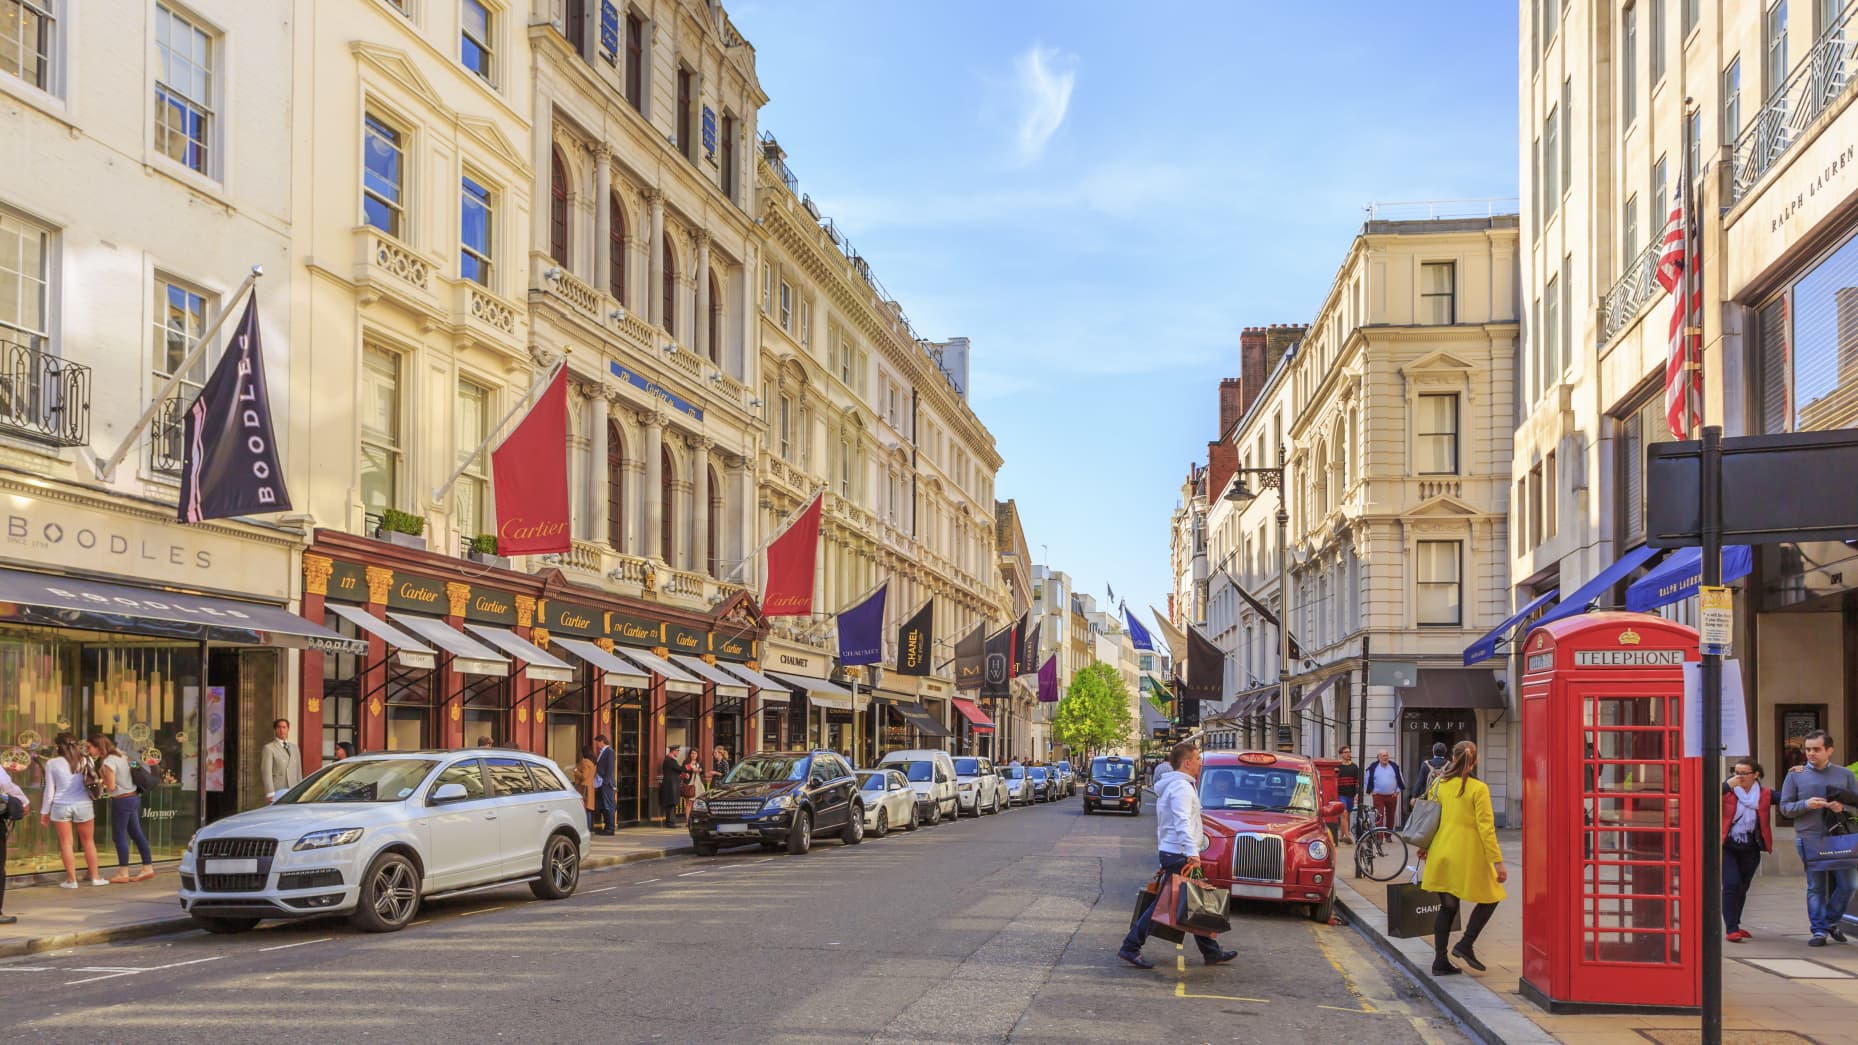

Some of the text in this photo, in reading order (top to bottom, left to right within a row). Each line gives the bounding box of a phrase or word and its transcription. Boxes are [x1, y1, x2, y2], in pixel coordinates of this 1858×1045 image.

[1771, 144, 1854, 233] RALPH LAUREN
[501, 518, 568, 539] Cartier
[8, 515, 212, 568] BOODLES
[340, 577, 356, 589] 177
[400, 582, 438, 603] Cartier
[766, 593, 810, 607] Cartier
[45, 587, 249, 618] BOODLES
[475, 596, 508, 614] Cartier
[560, 611, 591, 629] Cartier
[623, 622, 649, 639] Cartier
[676, 632, 698, 648] Cartier
[723, 640, 743, 655] Cartier
[907, 628, 918, 668] CHANEL
[780, 654, 808, 668] CHAUMET
[842, 648, 880, 657] CHAUMET
[1578, 651, 1680, 665] TELEPHONE
[1410, 721, 1465, 730] GRAFF
